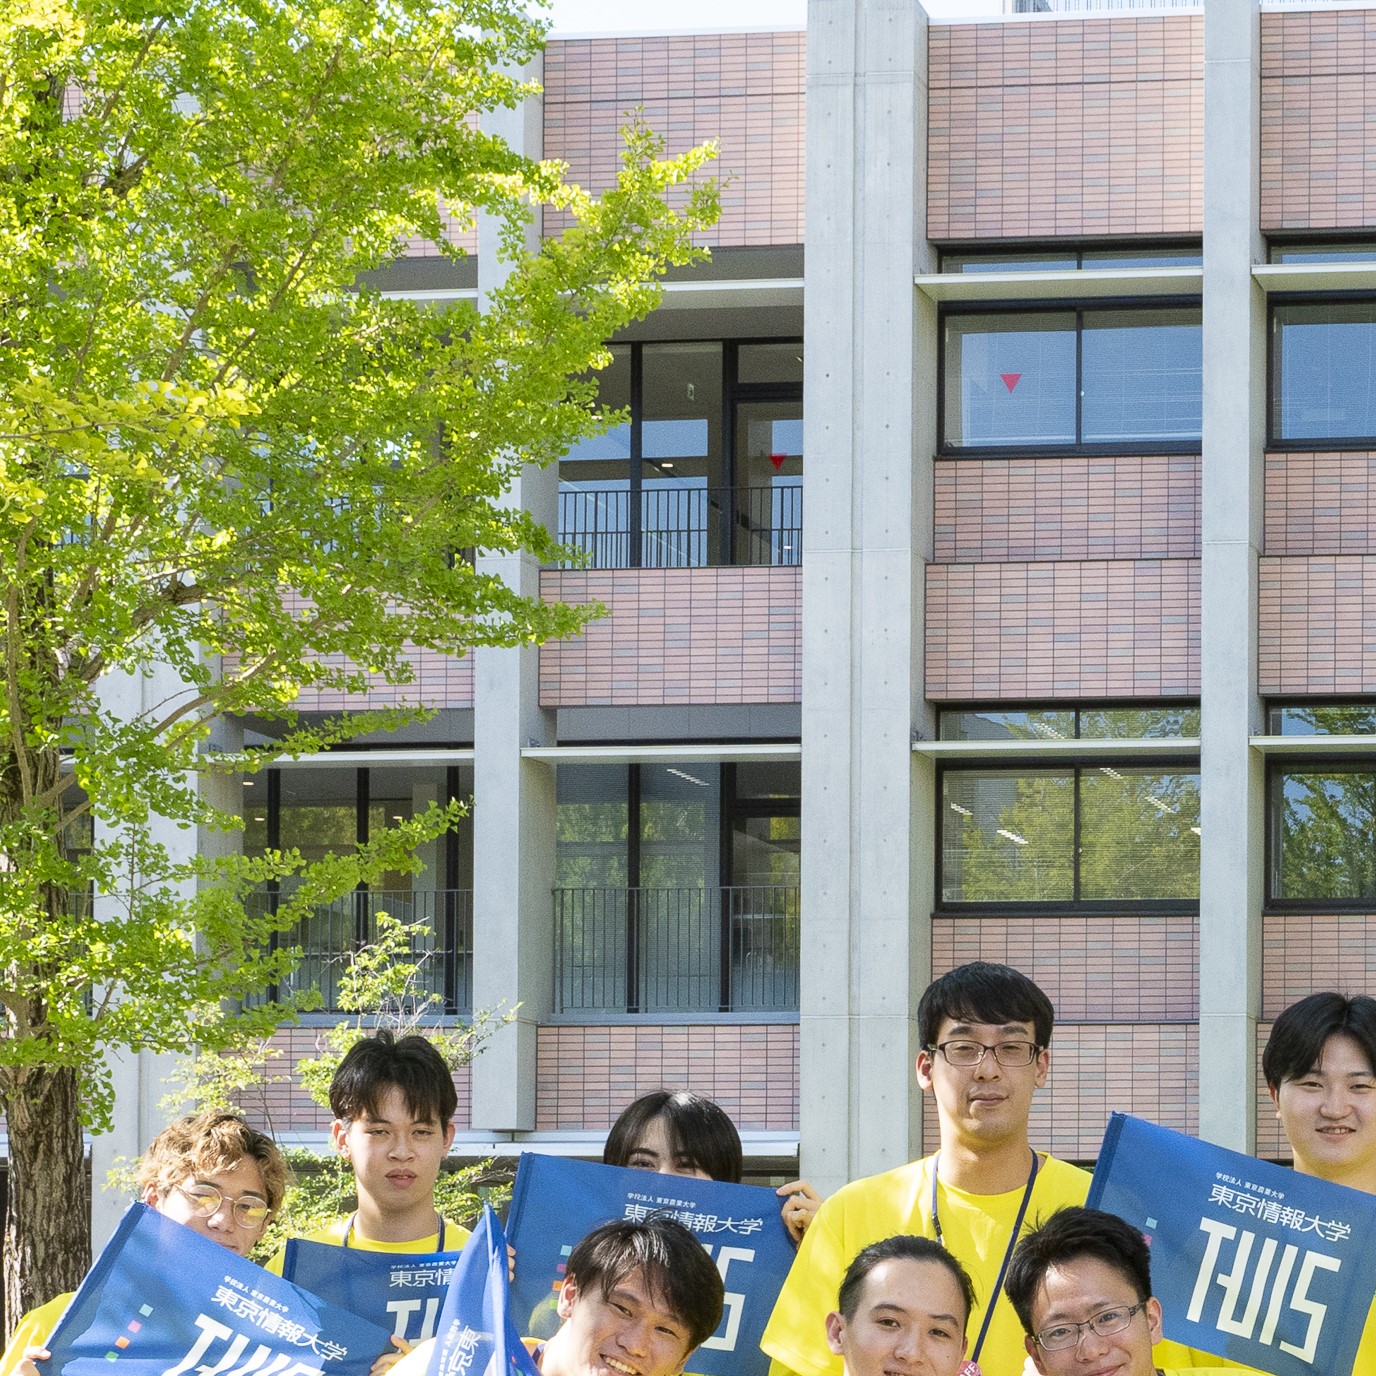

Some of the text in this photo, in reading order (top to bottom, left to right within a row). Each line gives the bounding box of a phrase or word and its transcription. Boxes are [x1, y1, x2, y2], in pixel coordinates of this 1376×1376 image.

[622, 1203, 763, 1235] 東情報大学
[1208, 1183, 1351, 1242] 東京情報大学
[210, 1285, 348, 1361] 東京情報大学
[1186, 1216, 1342, 1364] TUIS
